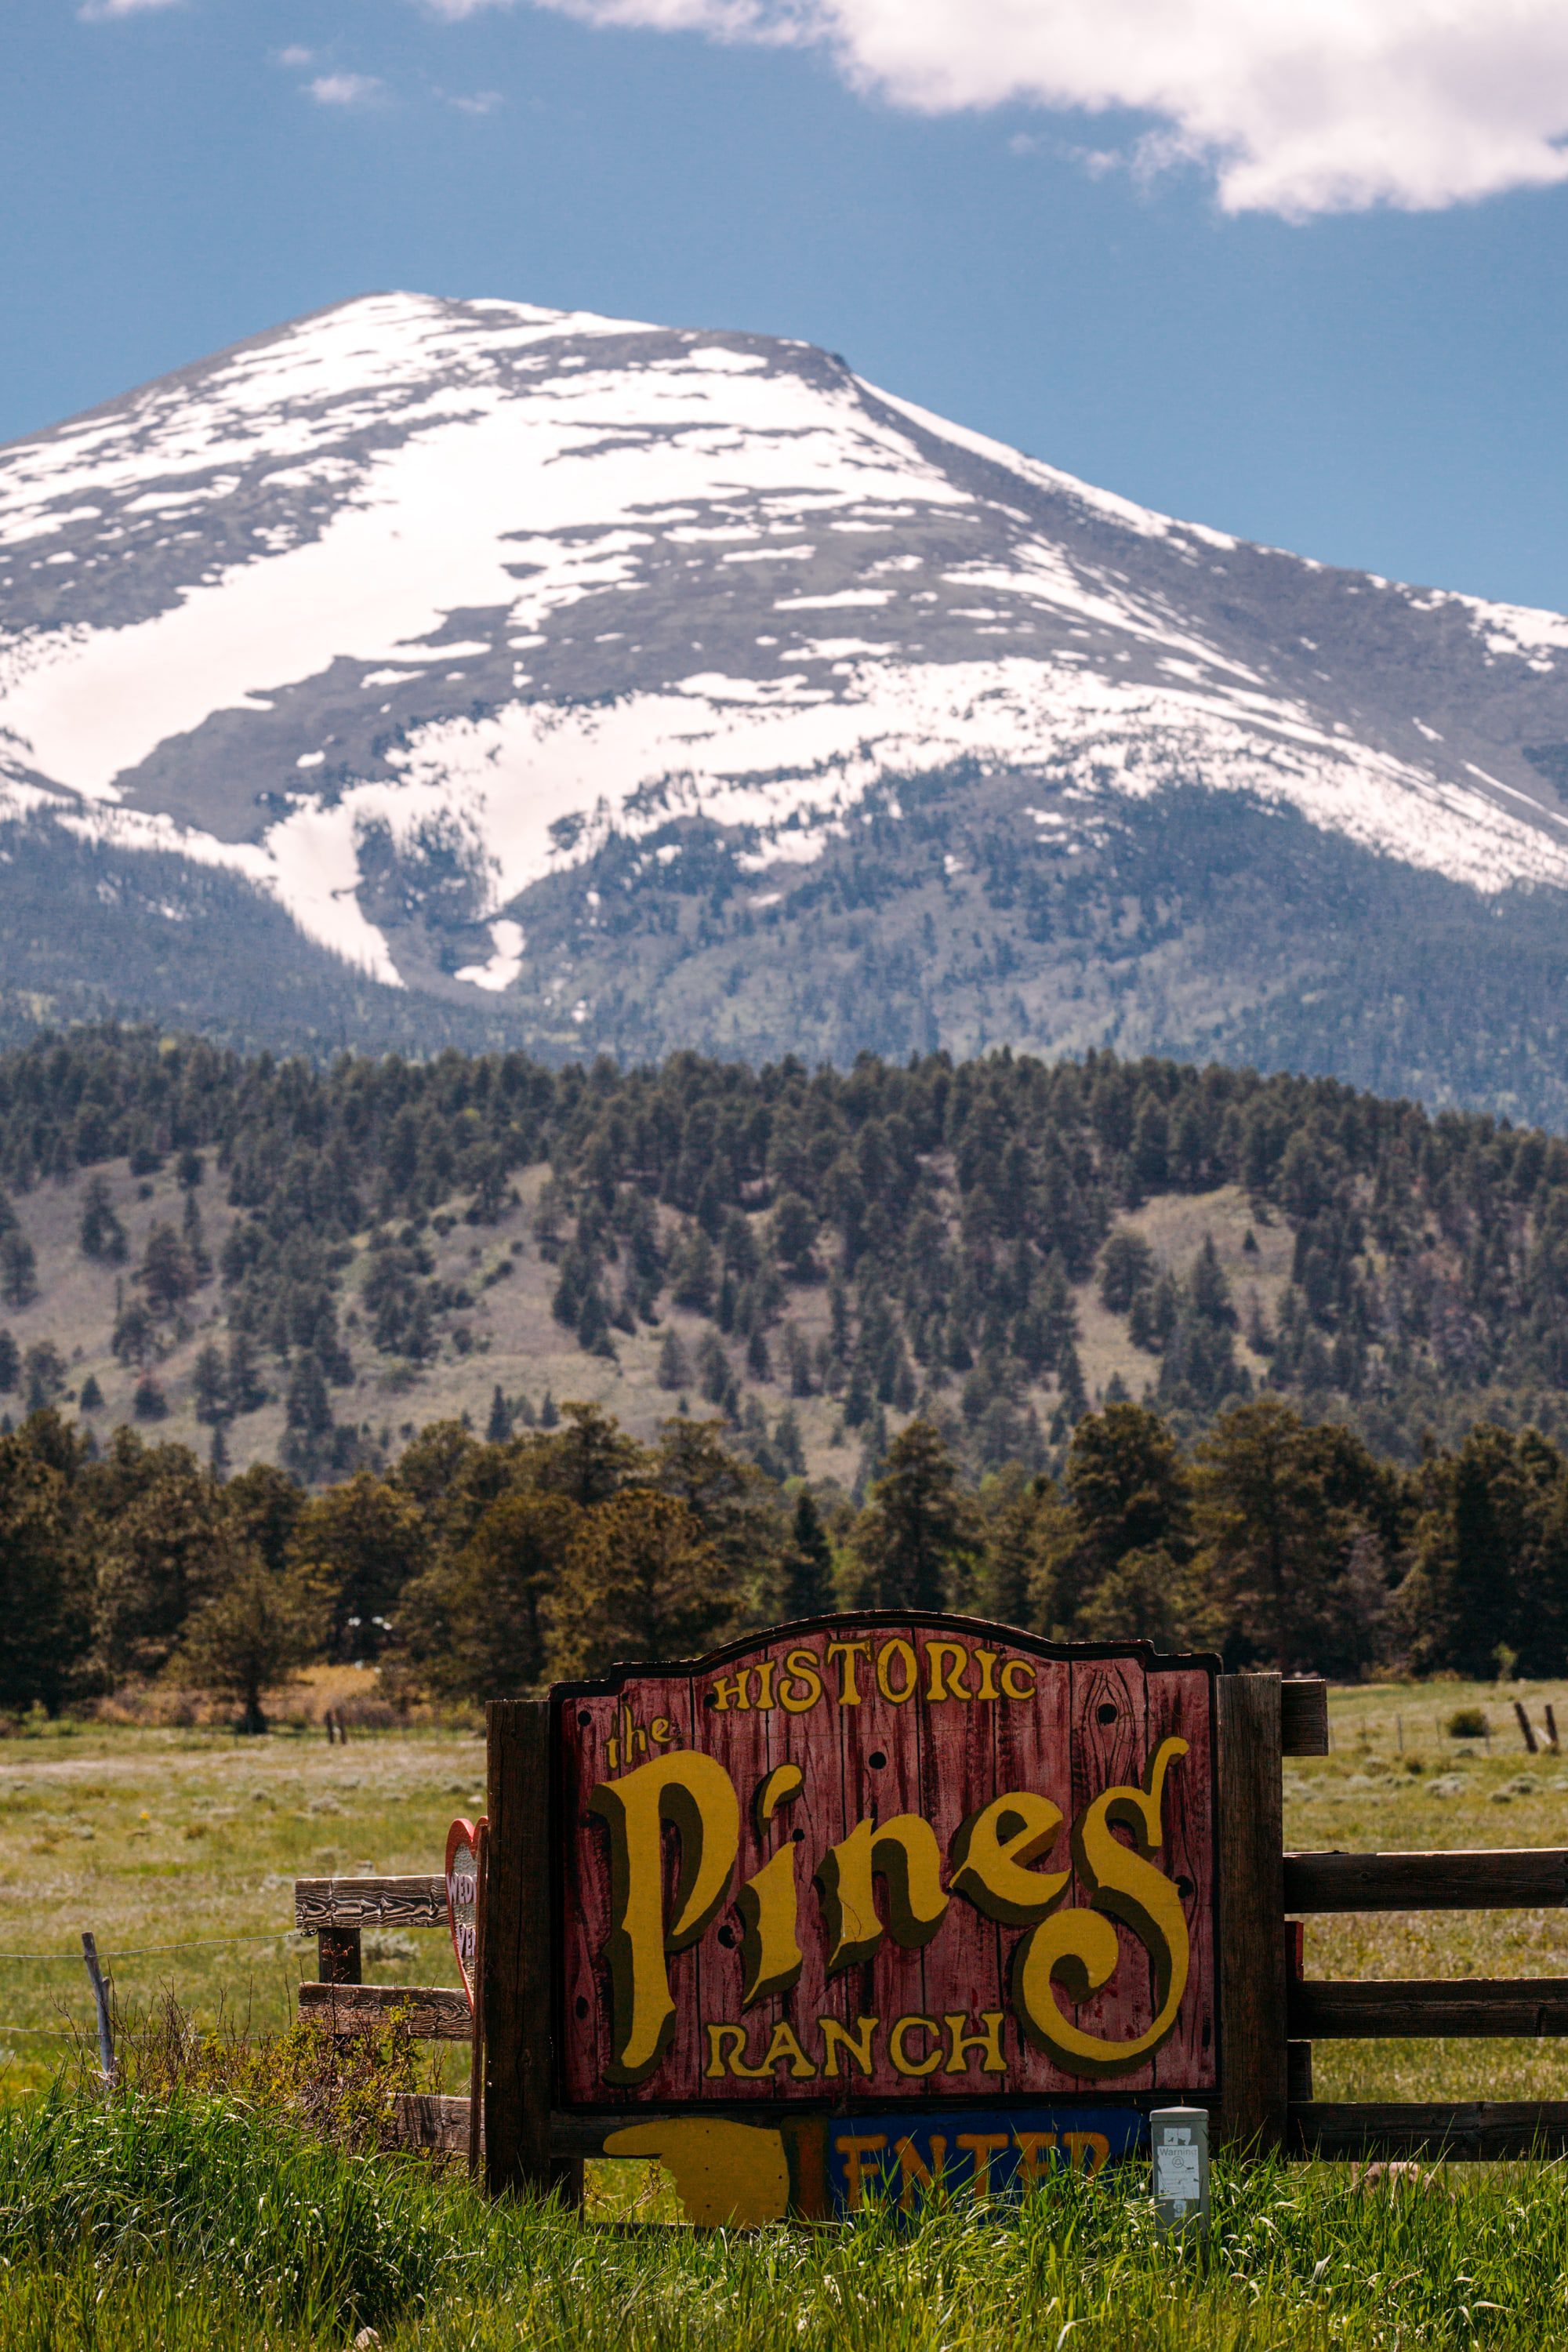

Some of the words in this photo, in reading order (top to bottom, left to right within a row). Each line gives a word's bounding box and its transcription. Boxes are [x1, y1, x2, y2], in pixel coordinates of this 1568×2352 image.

[711, 1637, 1036, 1713] HISTORIC
[605, 1703, 671, 1769] the
[706, 2010, 1008, 2079] RANCH
